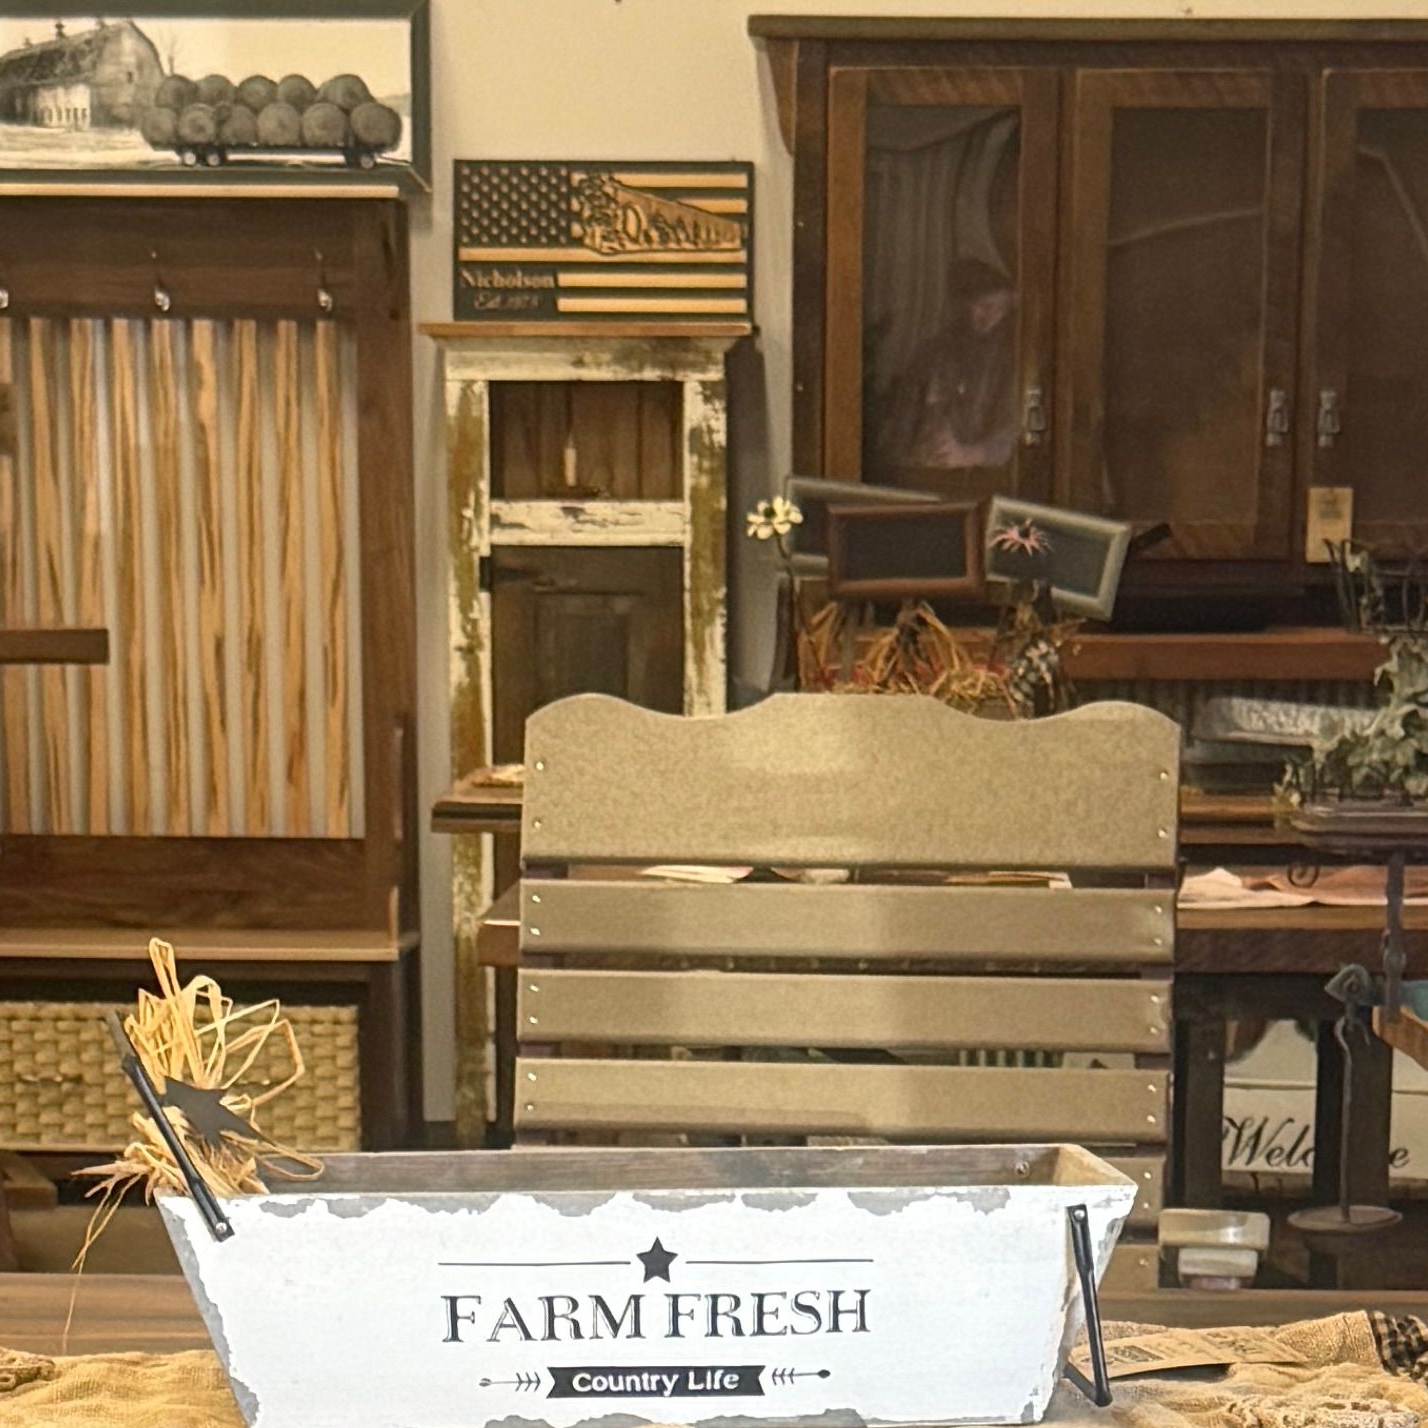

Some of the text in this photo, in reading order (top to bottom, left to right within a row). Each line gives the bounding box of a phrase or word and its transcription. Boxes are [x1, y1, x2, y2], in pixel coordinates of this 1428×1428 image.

[440, 1289, 871, 1342] FARM FRESH
[572, 1371, 740, 1397] Country Life
